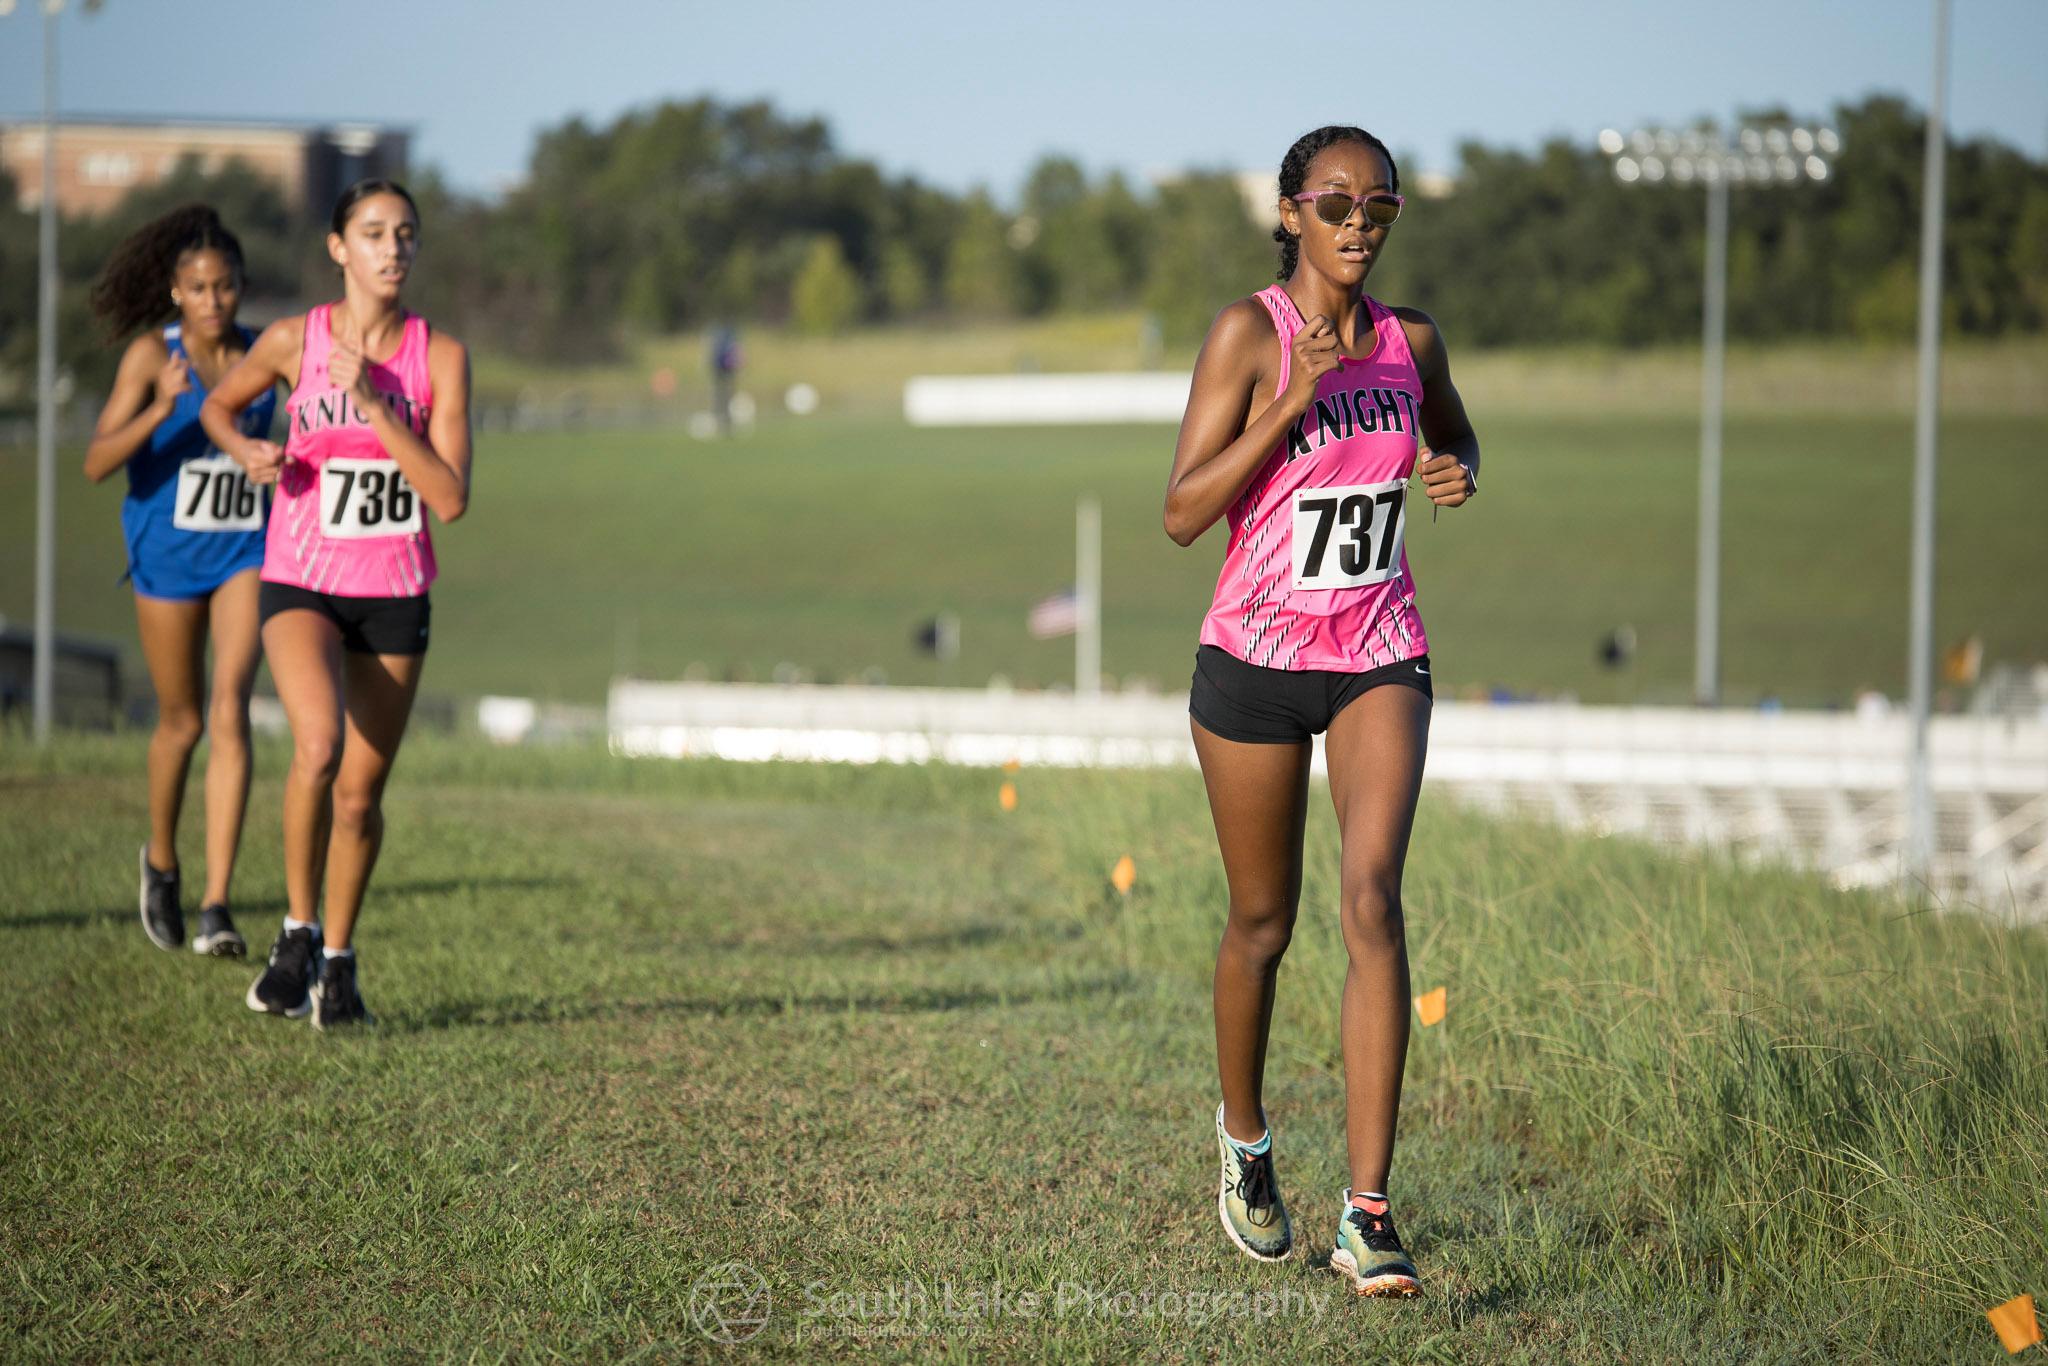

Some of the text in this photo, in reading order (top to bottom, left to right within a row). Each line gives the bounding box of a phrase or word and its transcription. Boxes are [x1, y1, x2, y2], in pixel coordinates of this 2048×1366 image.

[1285, 387, 1420, 466] KNIGHT
[185, 468, 255, 519] 706
[327, 468, 412, 526] 736
[1299, 488, 1404, 578] 737
